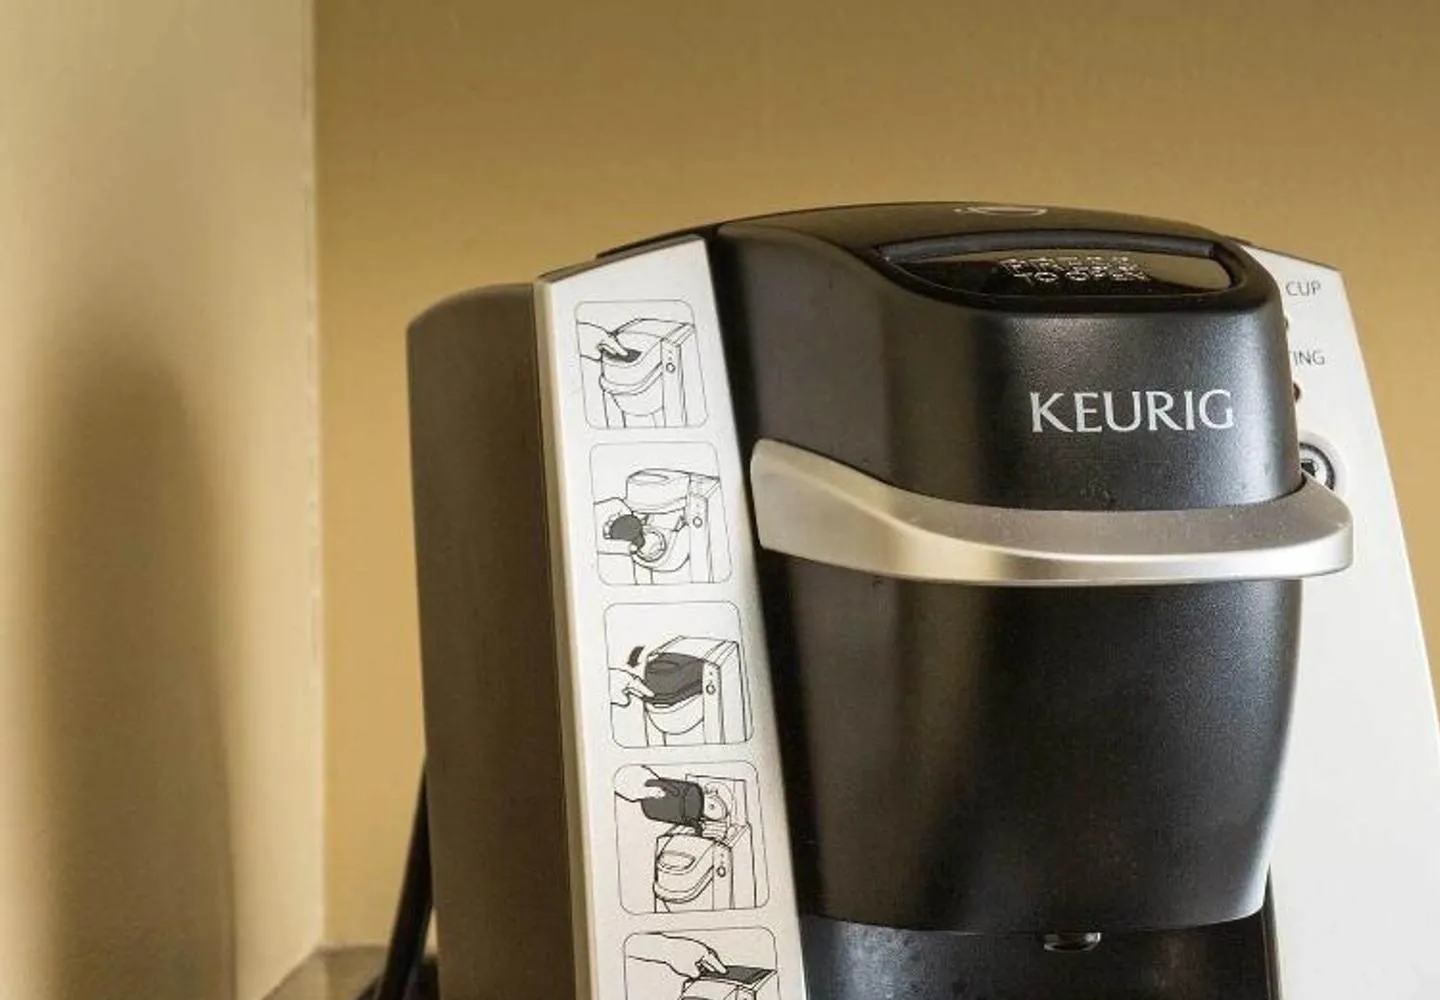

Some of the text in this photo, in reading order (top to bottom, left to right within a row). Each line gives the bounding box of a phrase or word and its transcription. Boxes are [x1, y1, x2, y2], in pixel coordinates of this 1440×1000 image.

[1286, 280, 1321, 297] CUP
[1289, 350, 1326, 367] ING
[1030, 390, 1236, 434] KEURIG
